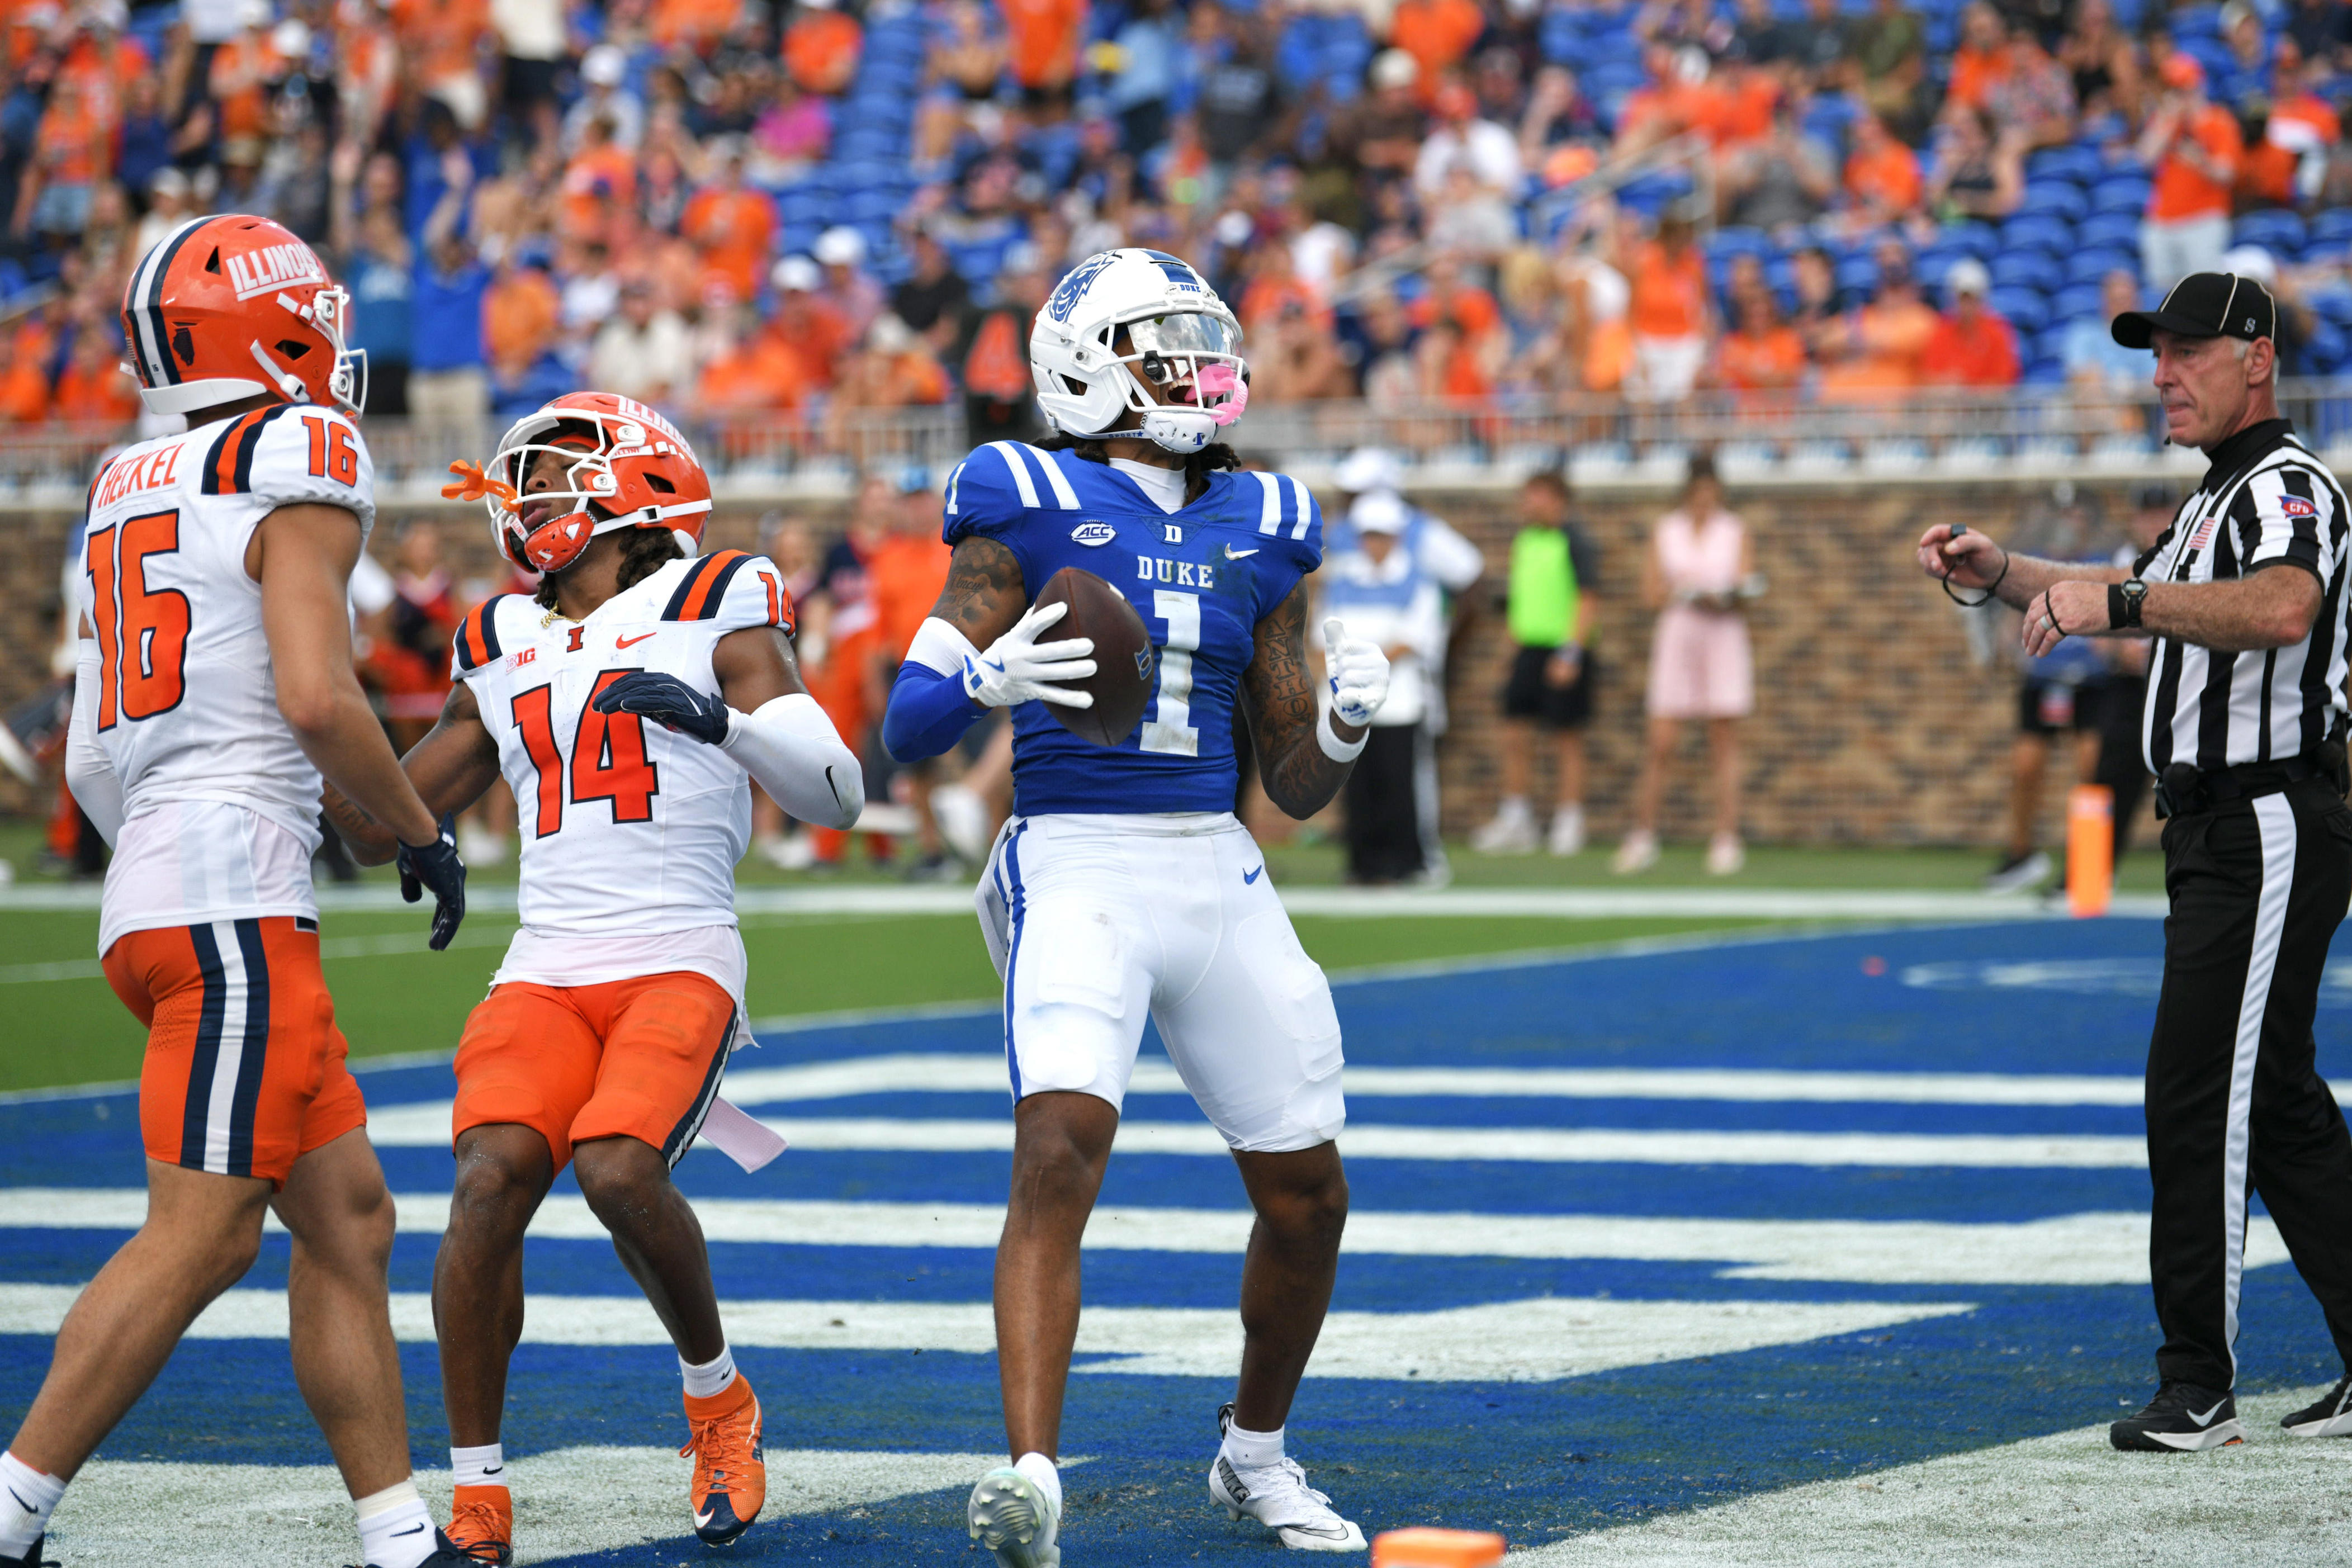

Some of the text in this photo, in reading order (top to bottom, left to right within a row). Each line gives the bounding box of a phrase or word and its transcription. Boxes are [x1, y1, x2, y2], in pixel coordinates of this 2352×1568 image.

[1180, 284, 1201, 292] DUKE
[2244, 317, 2256, 334] S
[98, 442, 186, 508] HECKEL
[302, 416, 358, 487] 16
[947, 462, 967, 515] 1
[1077, 527, 1111, 537] ACC
[1163, 523, 1182, 544] D
[1137, 555, 1213, 589] DUKE
[87, 508, 191, 733] 16
[566, 625, 585, 653] I
[1139, 589, 1201, 757] 1
[511, 667, 659, 840] 14
[1218, 1456, 1251, 1505] NIKE
